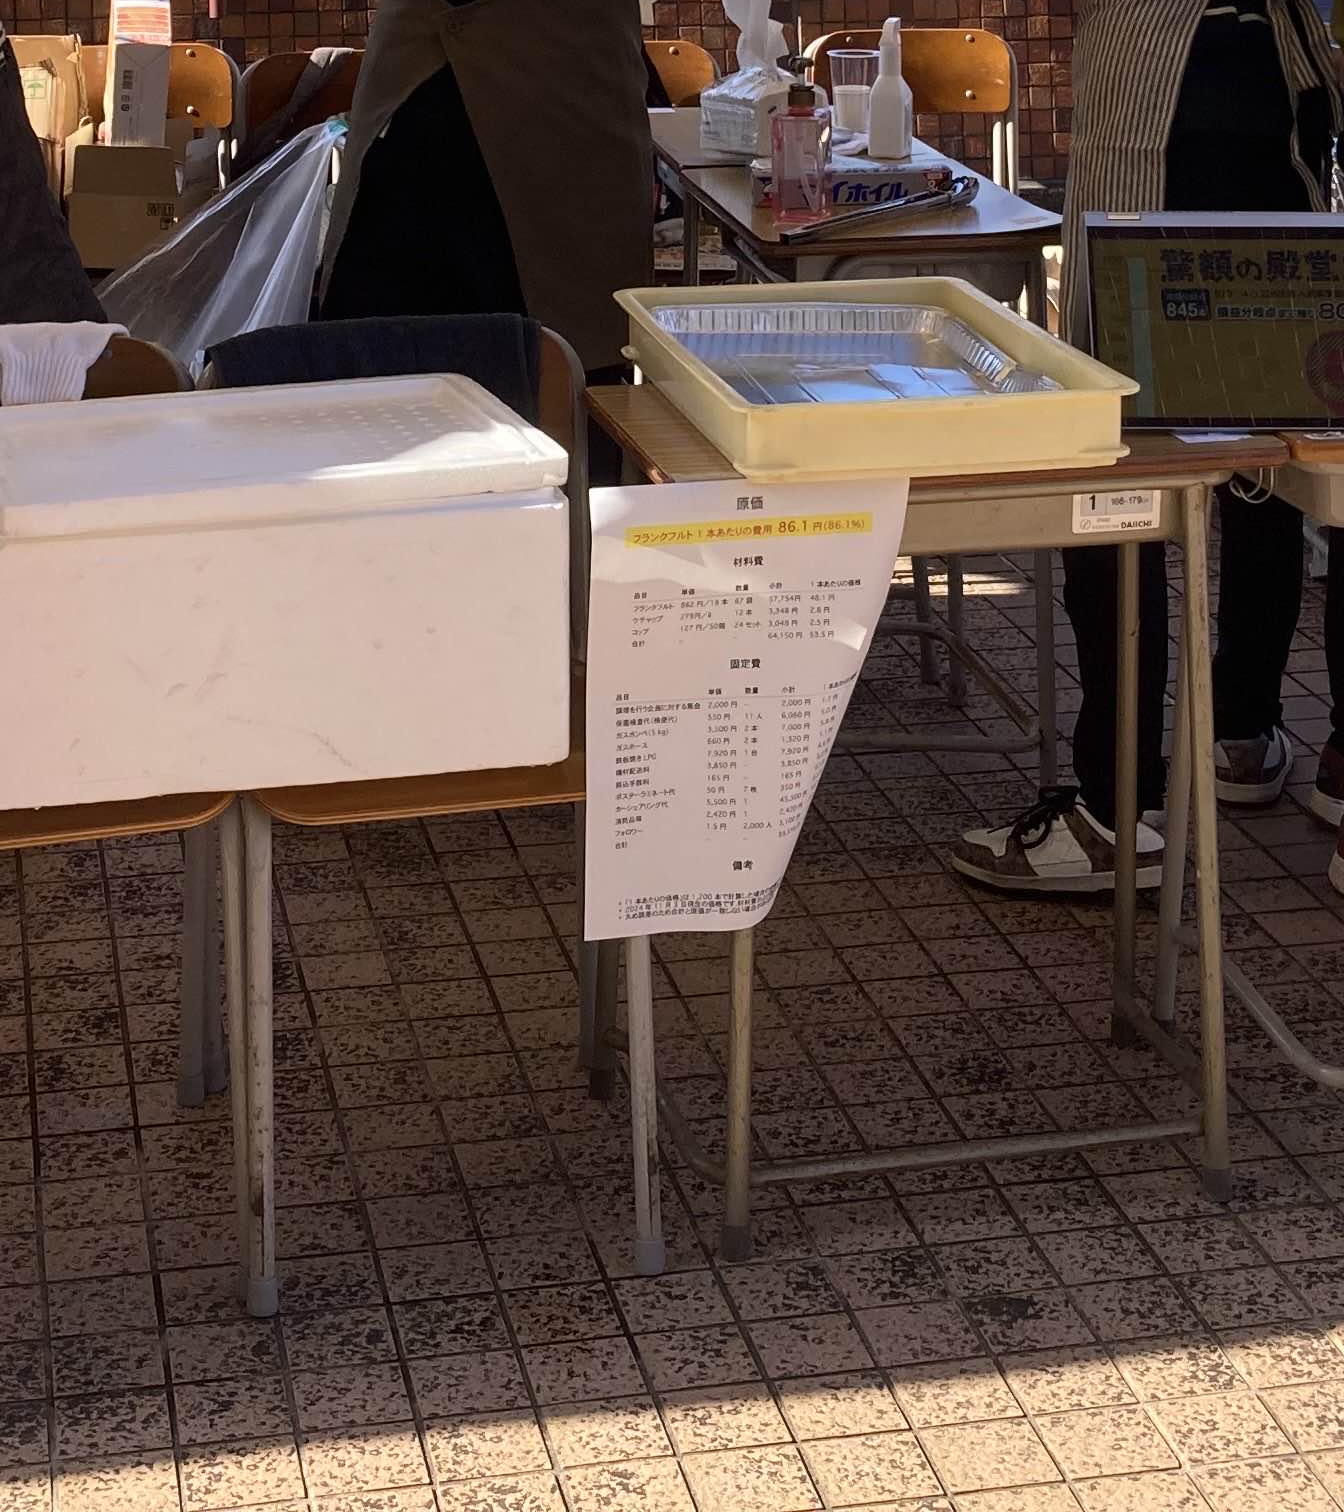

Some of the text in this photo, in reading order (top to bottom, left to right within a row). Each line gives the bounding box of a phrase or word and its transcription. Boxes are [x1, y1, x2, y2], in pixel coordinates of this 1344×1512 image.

[632, 530, 693, 545] フランクフルト
[778, 520, 807, 534] 86.1
